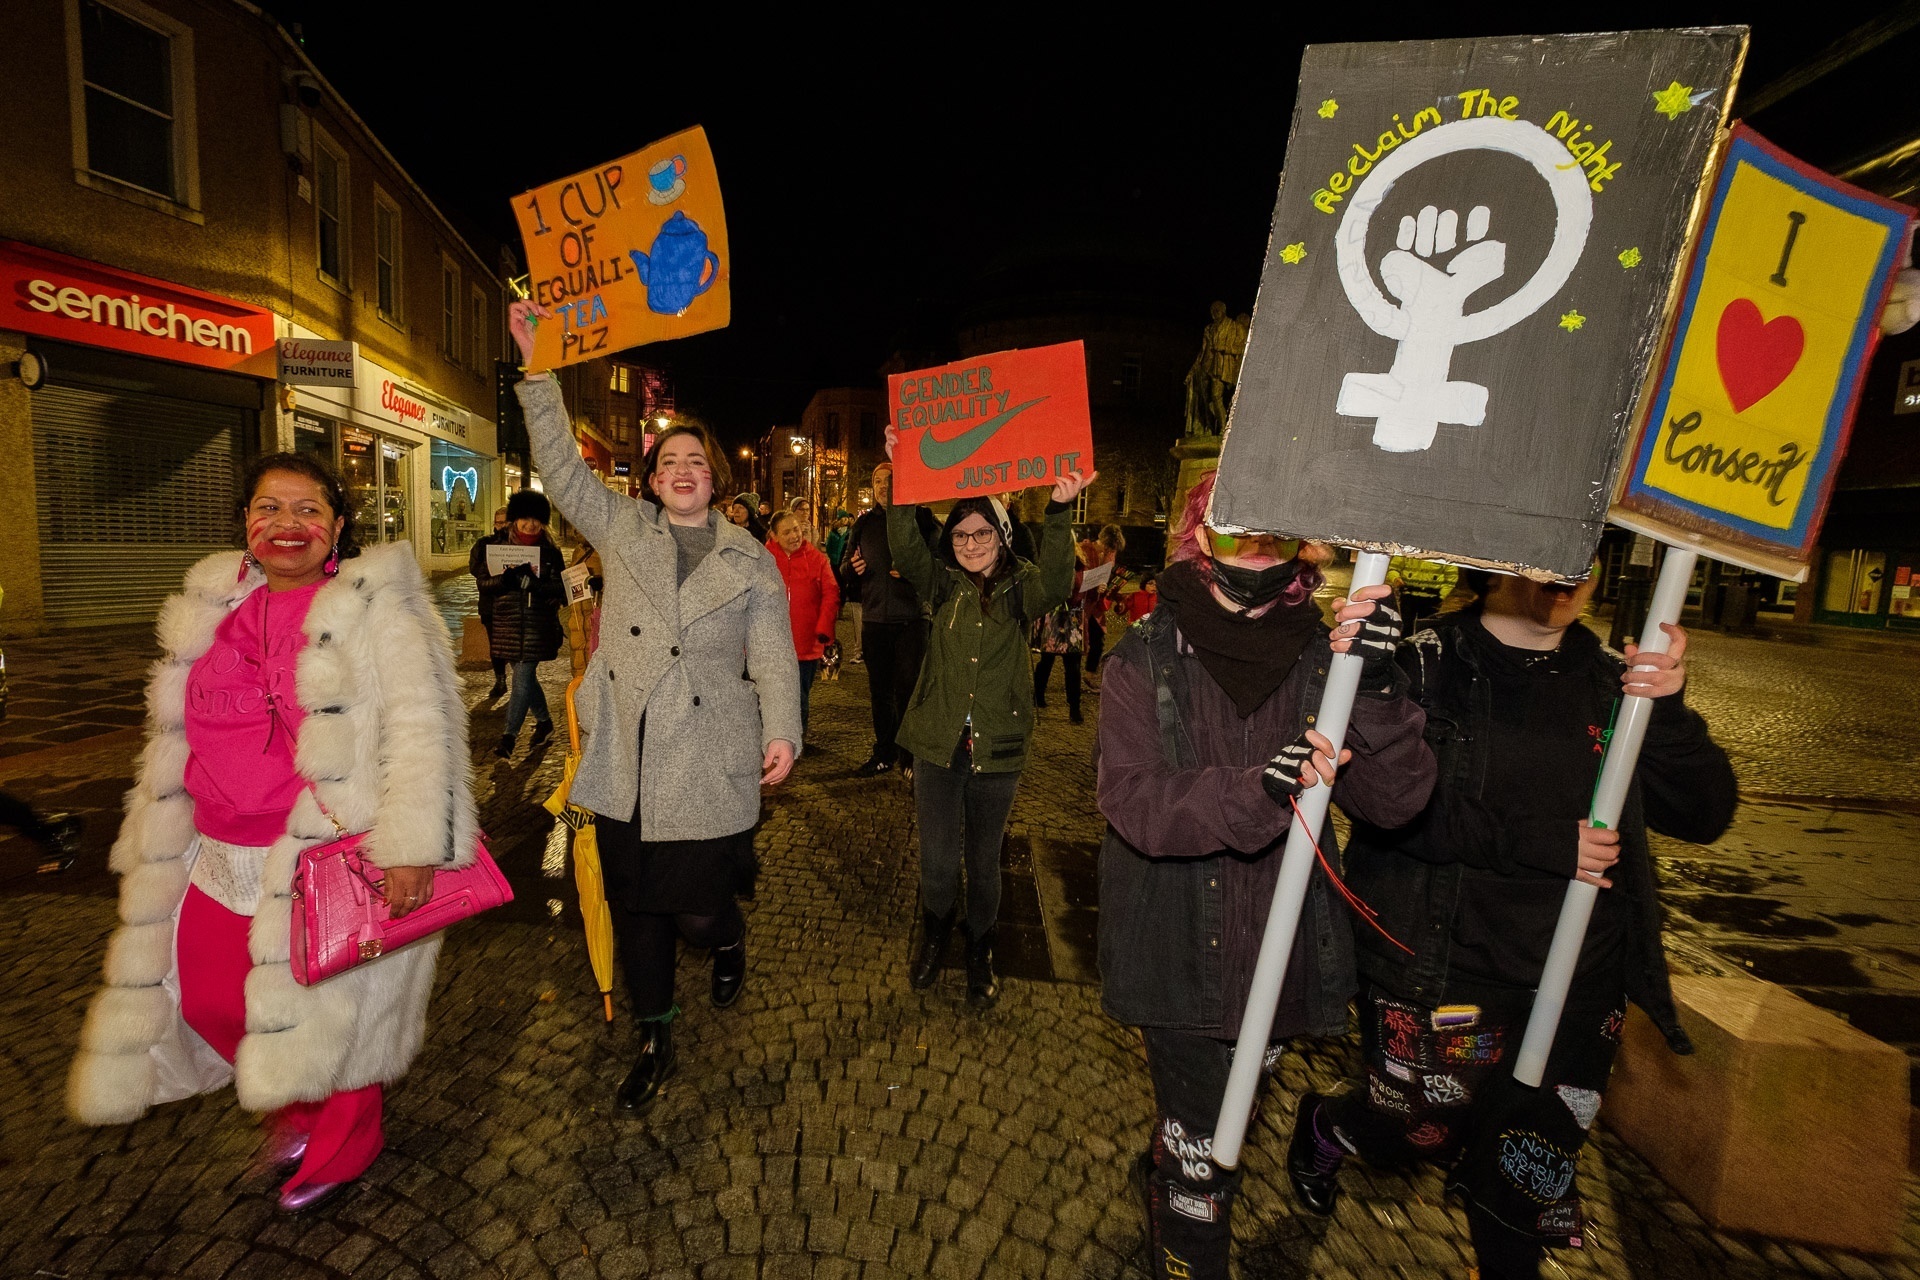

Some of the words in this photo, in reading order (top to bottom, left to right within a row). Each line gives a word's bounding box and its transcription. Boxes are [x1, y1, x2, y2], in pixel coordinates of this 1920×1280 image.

[1310, 107, 1441, 214] Reclaim
[1458, 88, 1520, 121] The
[1545, 110, 1622, 193] Night
[527, 195, 552, 237] 1
[560, 165, 622, 226] CUP
[560, 224, 596, 269] OF
[1769, 211, 1806, 288] I
[28, 279, 252, 354] semichem
[555, 294, 608, 332] TEA
[282, 341, 352, 365] Elegance
[562, 326, 609, 361] PLZ
[283, 366, 352, 379] FURNITURE
[901, 366, 993, 406] GENDER
[382, 380, 425, 423] Elegance
[432, 412, 465, 439] FURNITURE
[897, 389, 1010, 431] EQUALITY
[956, 462, 1012, 489] JUST
[1018, 457, 1047, 480] DO
[1664, 411, 1806, 507] Consent
[1387, 1039, 1415, 1060] SIN
[1379, 1082, 1405, 1100] BODY
[1423, 1073, 1460, 1088] FCK
[1423, 1086, 1465, 1103] NZS
[1373, 1093, 1411, 1113] CHOICE
[1162, 1118, 1183, 1138] NO
[1162, 1136, 1212, 1158] MEANS
[1520, 1138, 1556, 1165] NOT
[1182, 1161, 1211, 1180] NO
[1499, 1154, 1530, 1184] ARE
[1556, 1207, 1573, 1216] GAY
